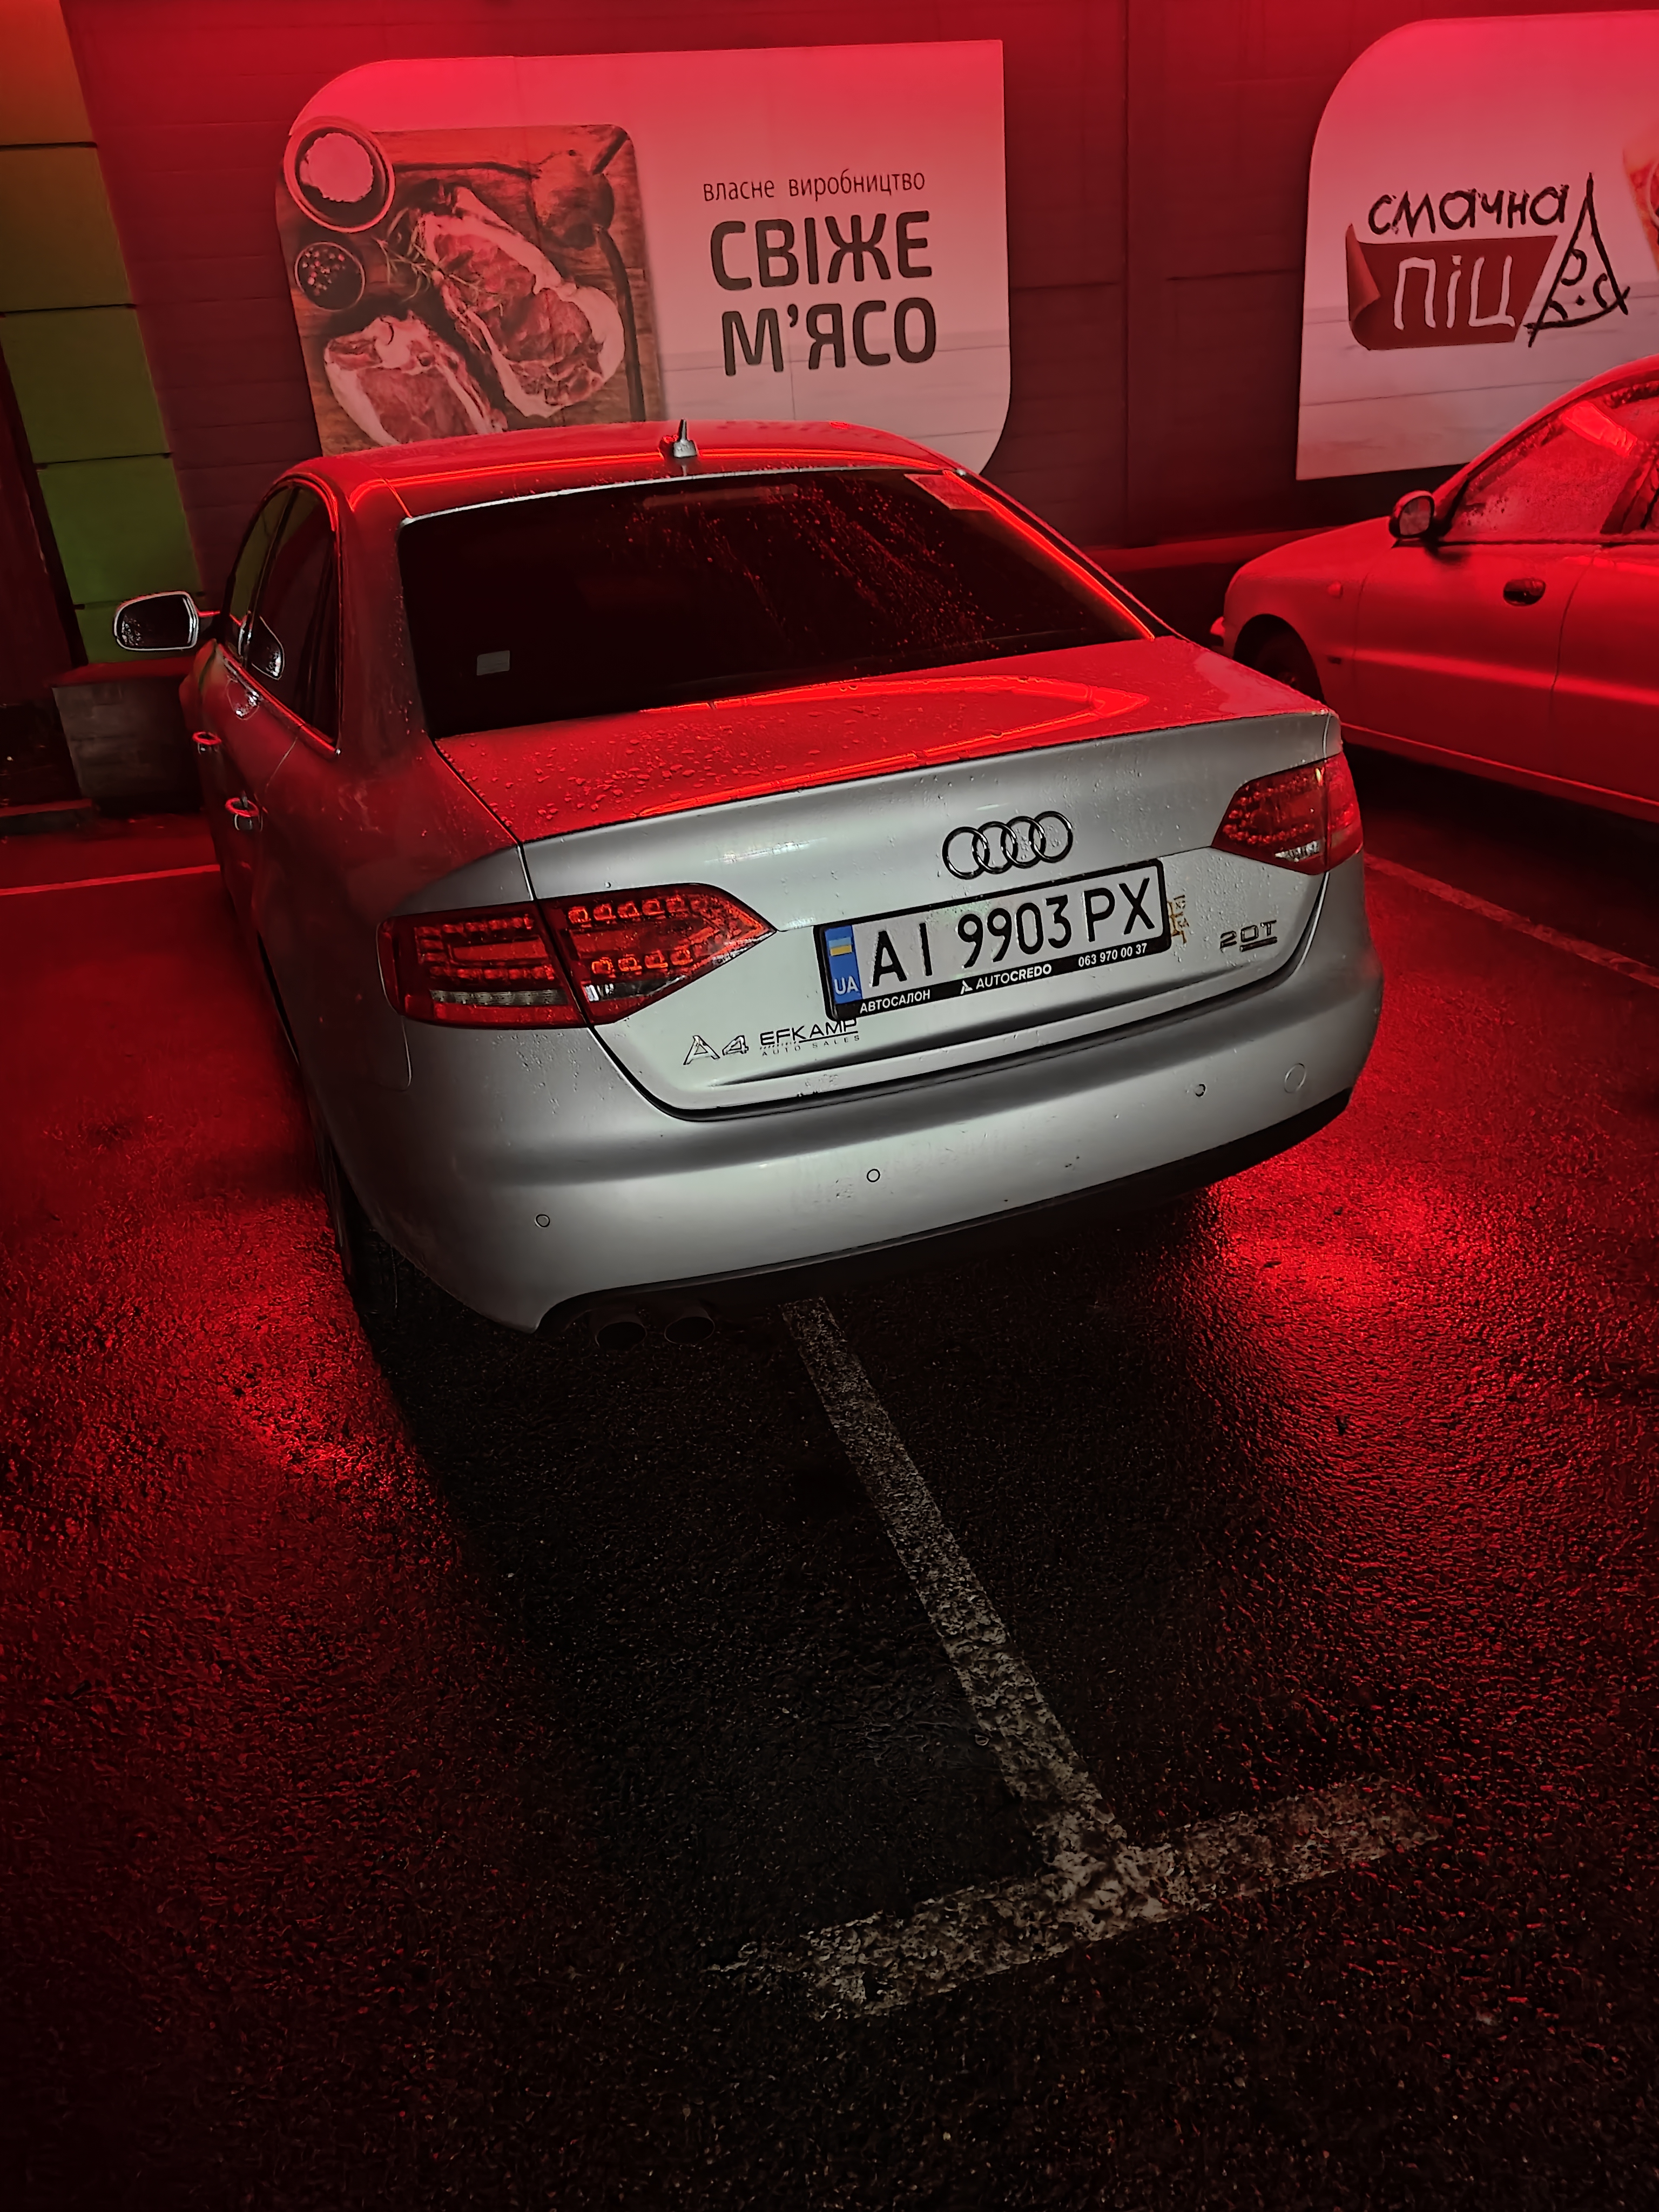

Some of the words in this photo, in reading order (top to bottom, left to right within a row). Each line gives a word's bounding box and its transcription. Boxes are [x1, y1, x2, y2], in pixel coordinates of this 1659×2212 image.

[703, 180, 774, 201] власне
[788, 168, 925, 201] виробництво
[710, 210, 932, 291] СВІЖЕ
[870, 922, 933, 987] AI
[956, 895, 1072, 969] 9903
[1084, 877, 1155, 943] PX
[1078, 954, 1097, 968] 063
[1100, 950, 1118, 964] 970
[1120, 947, 1133, 960] 00
[1135, 943, 1148, 956] 37
[834, 974, 859, 996] UA
[975, 963, 1053, 990] AUTOCREDO
[859, 989, 931, 1014] АВТОСАЛОН
[760, 1019, 857, 1046] EFKAMP
[762, 1045, 801, 1057] AUTO
[812, 1035, 860, 1048] SALES
[683, 1035, 749, 1065] A4
